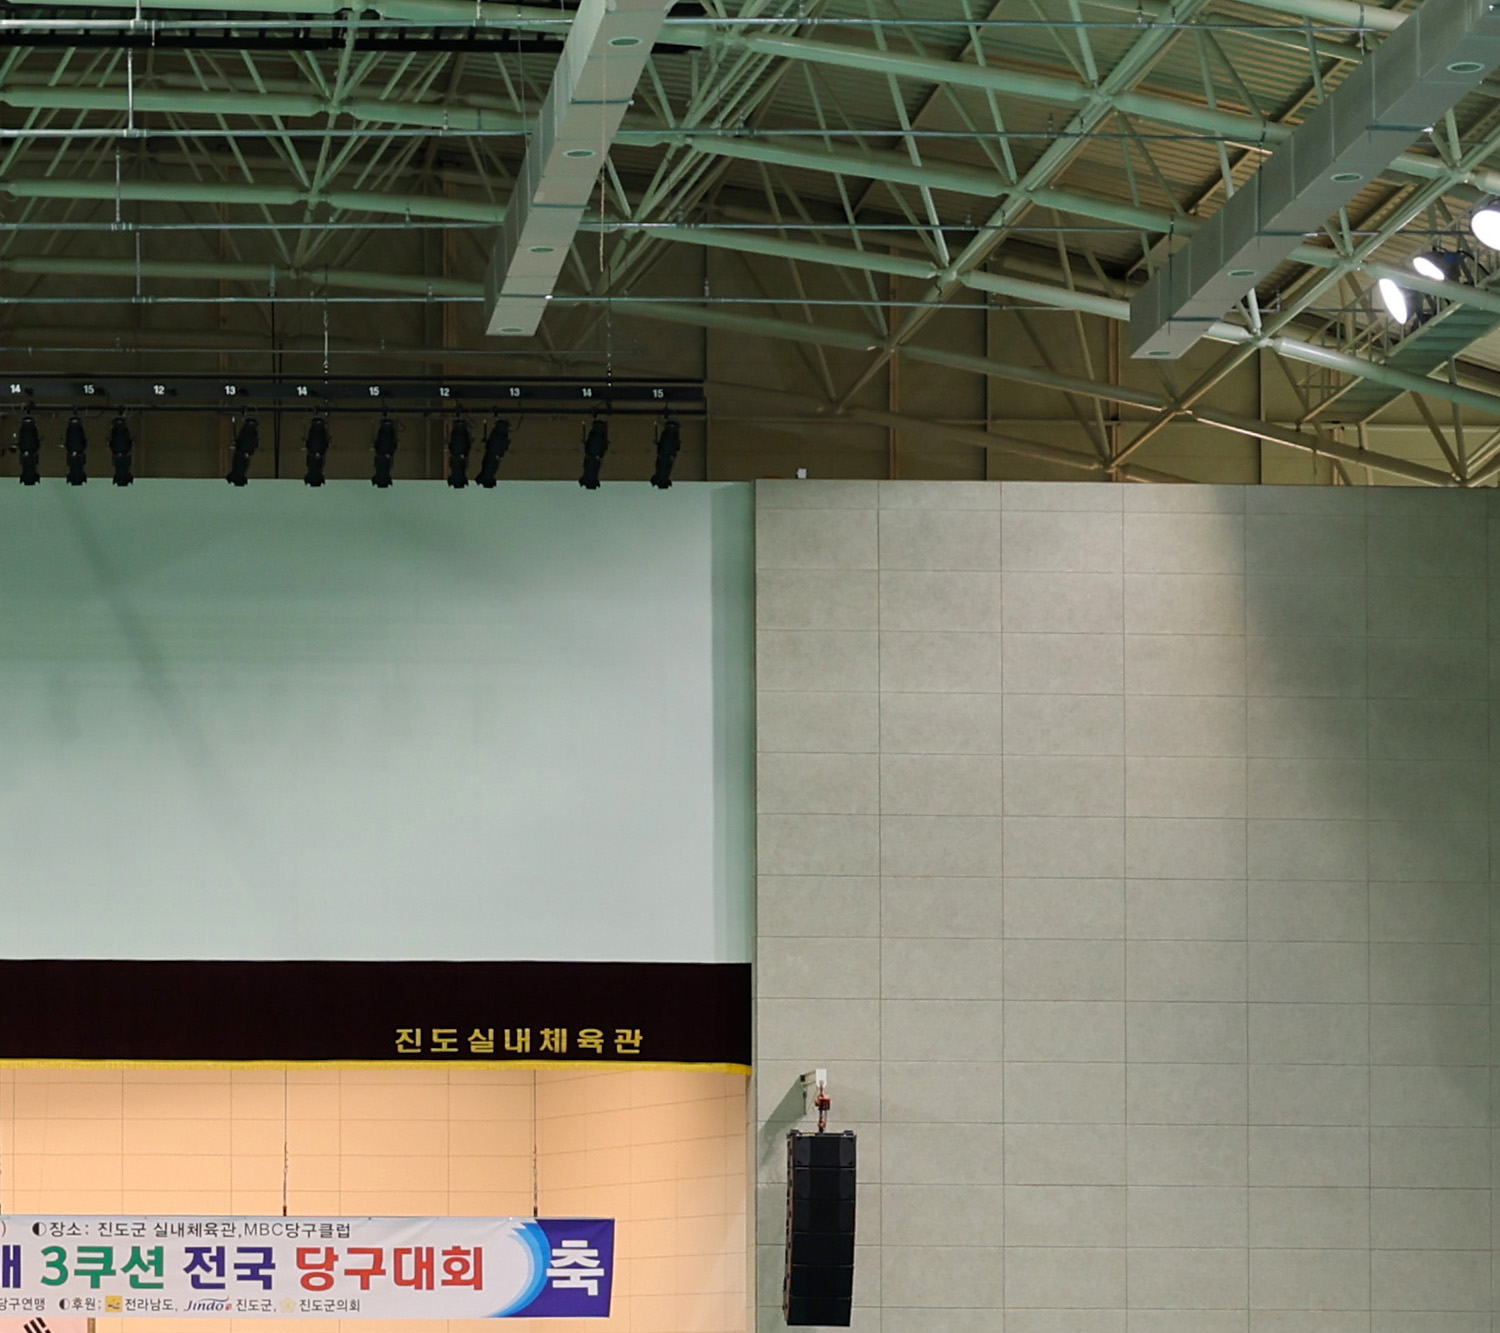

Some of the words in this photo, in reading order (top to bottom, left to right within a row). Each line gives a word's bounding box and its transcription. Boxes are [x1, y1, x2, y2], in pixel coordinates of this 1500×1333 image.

[394, 1027, 643, 1055] 진도실내체육관
[50, 1222, 89, 1238] 장소:
[97, 1222, 147, 1238] 진도군
[40, 1244, 164, 1290] 3쿠션
[184, 1245, 276, 1291] 전국
[295, 1245, 483, 1292] 당구대회
[545, 1239, 605, 1297] 축
[299, 1298, 361, 1313] 진도군의회
